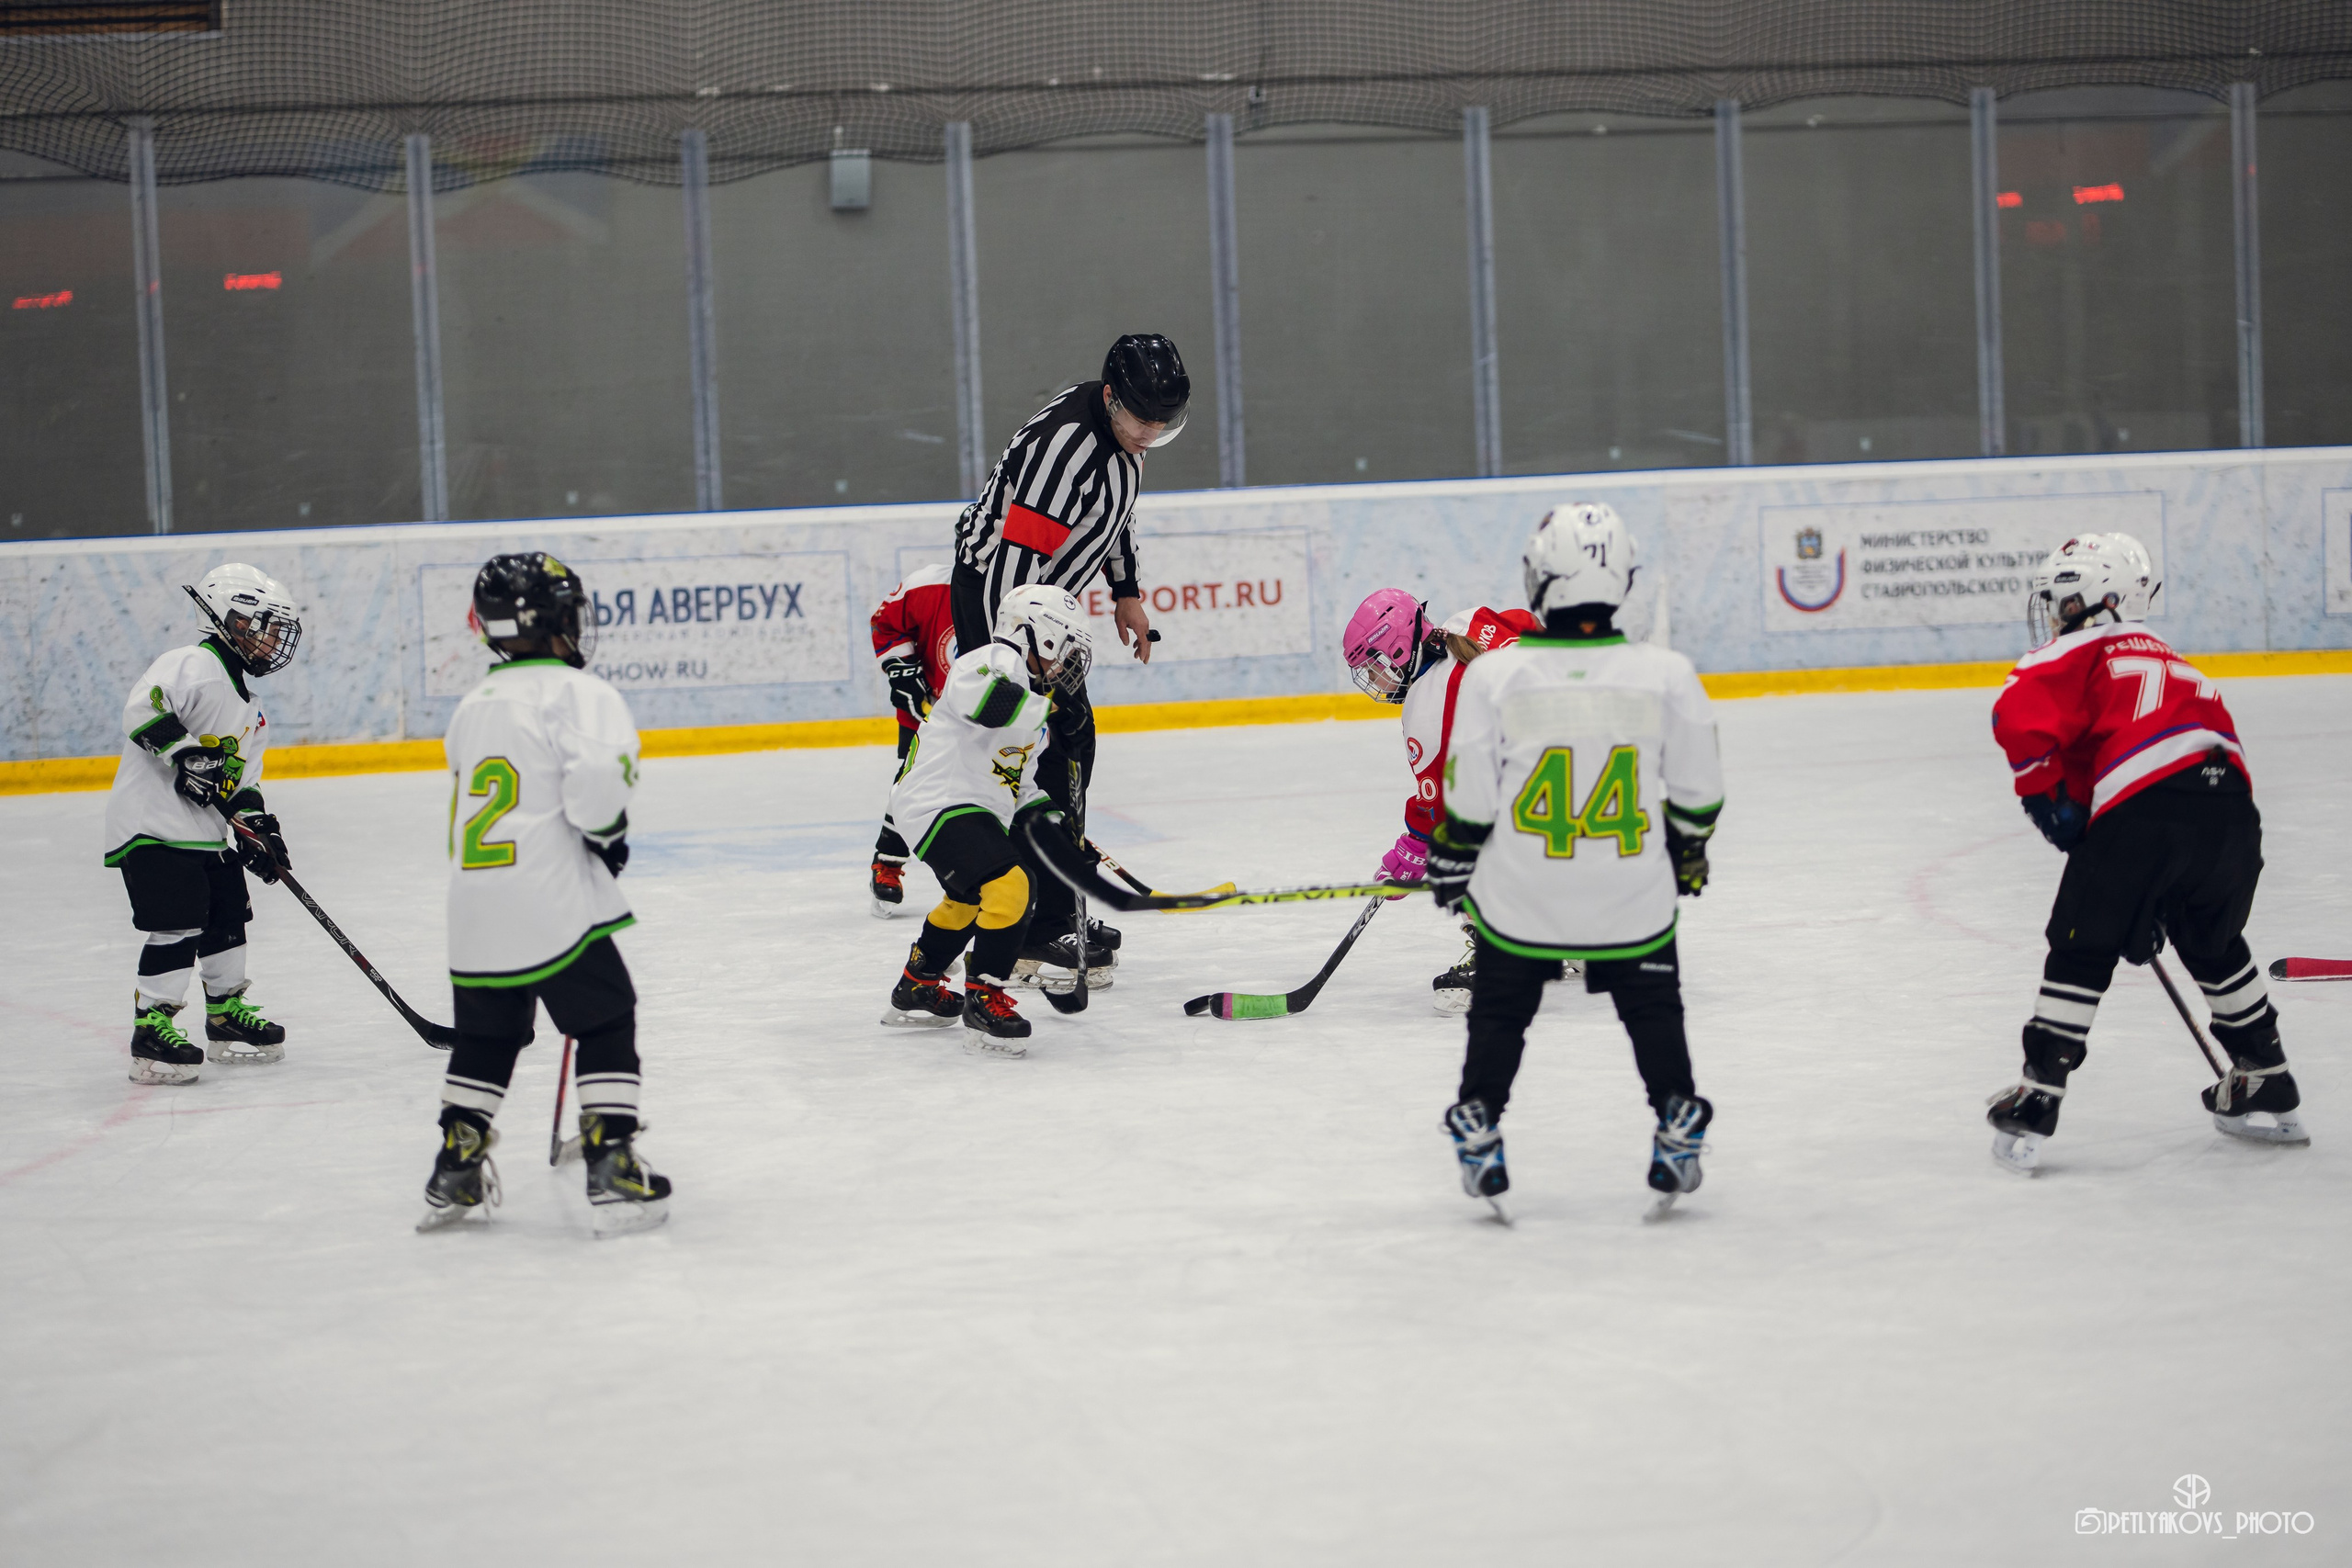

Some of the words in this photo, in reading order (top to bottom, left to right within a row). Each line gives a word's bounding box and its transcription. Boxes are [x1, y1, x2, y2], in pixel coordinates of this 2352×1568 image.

[1860, 528, 1989, 548] МИНИСТЕРСТВО
[1583, 543, 1606, 568] 71
[1863, 552, 1970, 573] ФИЗИЧЕСКОЙ
[1861, 577, 2020, 598] СТАВРОПОЛЬСКОГО
[232, 595, 258, 605] BAUER
[593, 590, 635, 626] ЬЯ
[649, 581, 804, 624] АВЕРБУХ
[1043, 613, 1064, 626] BAUER
[1368, 624, 1388, 644] BAUER
[1512, 745, 1650, 858] 44
